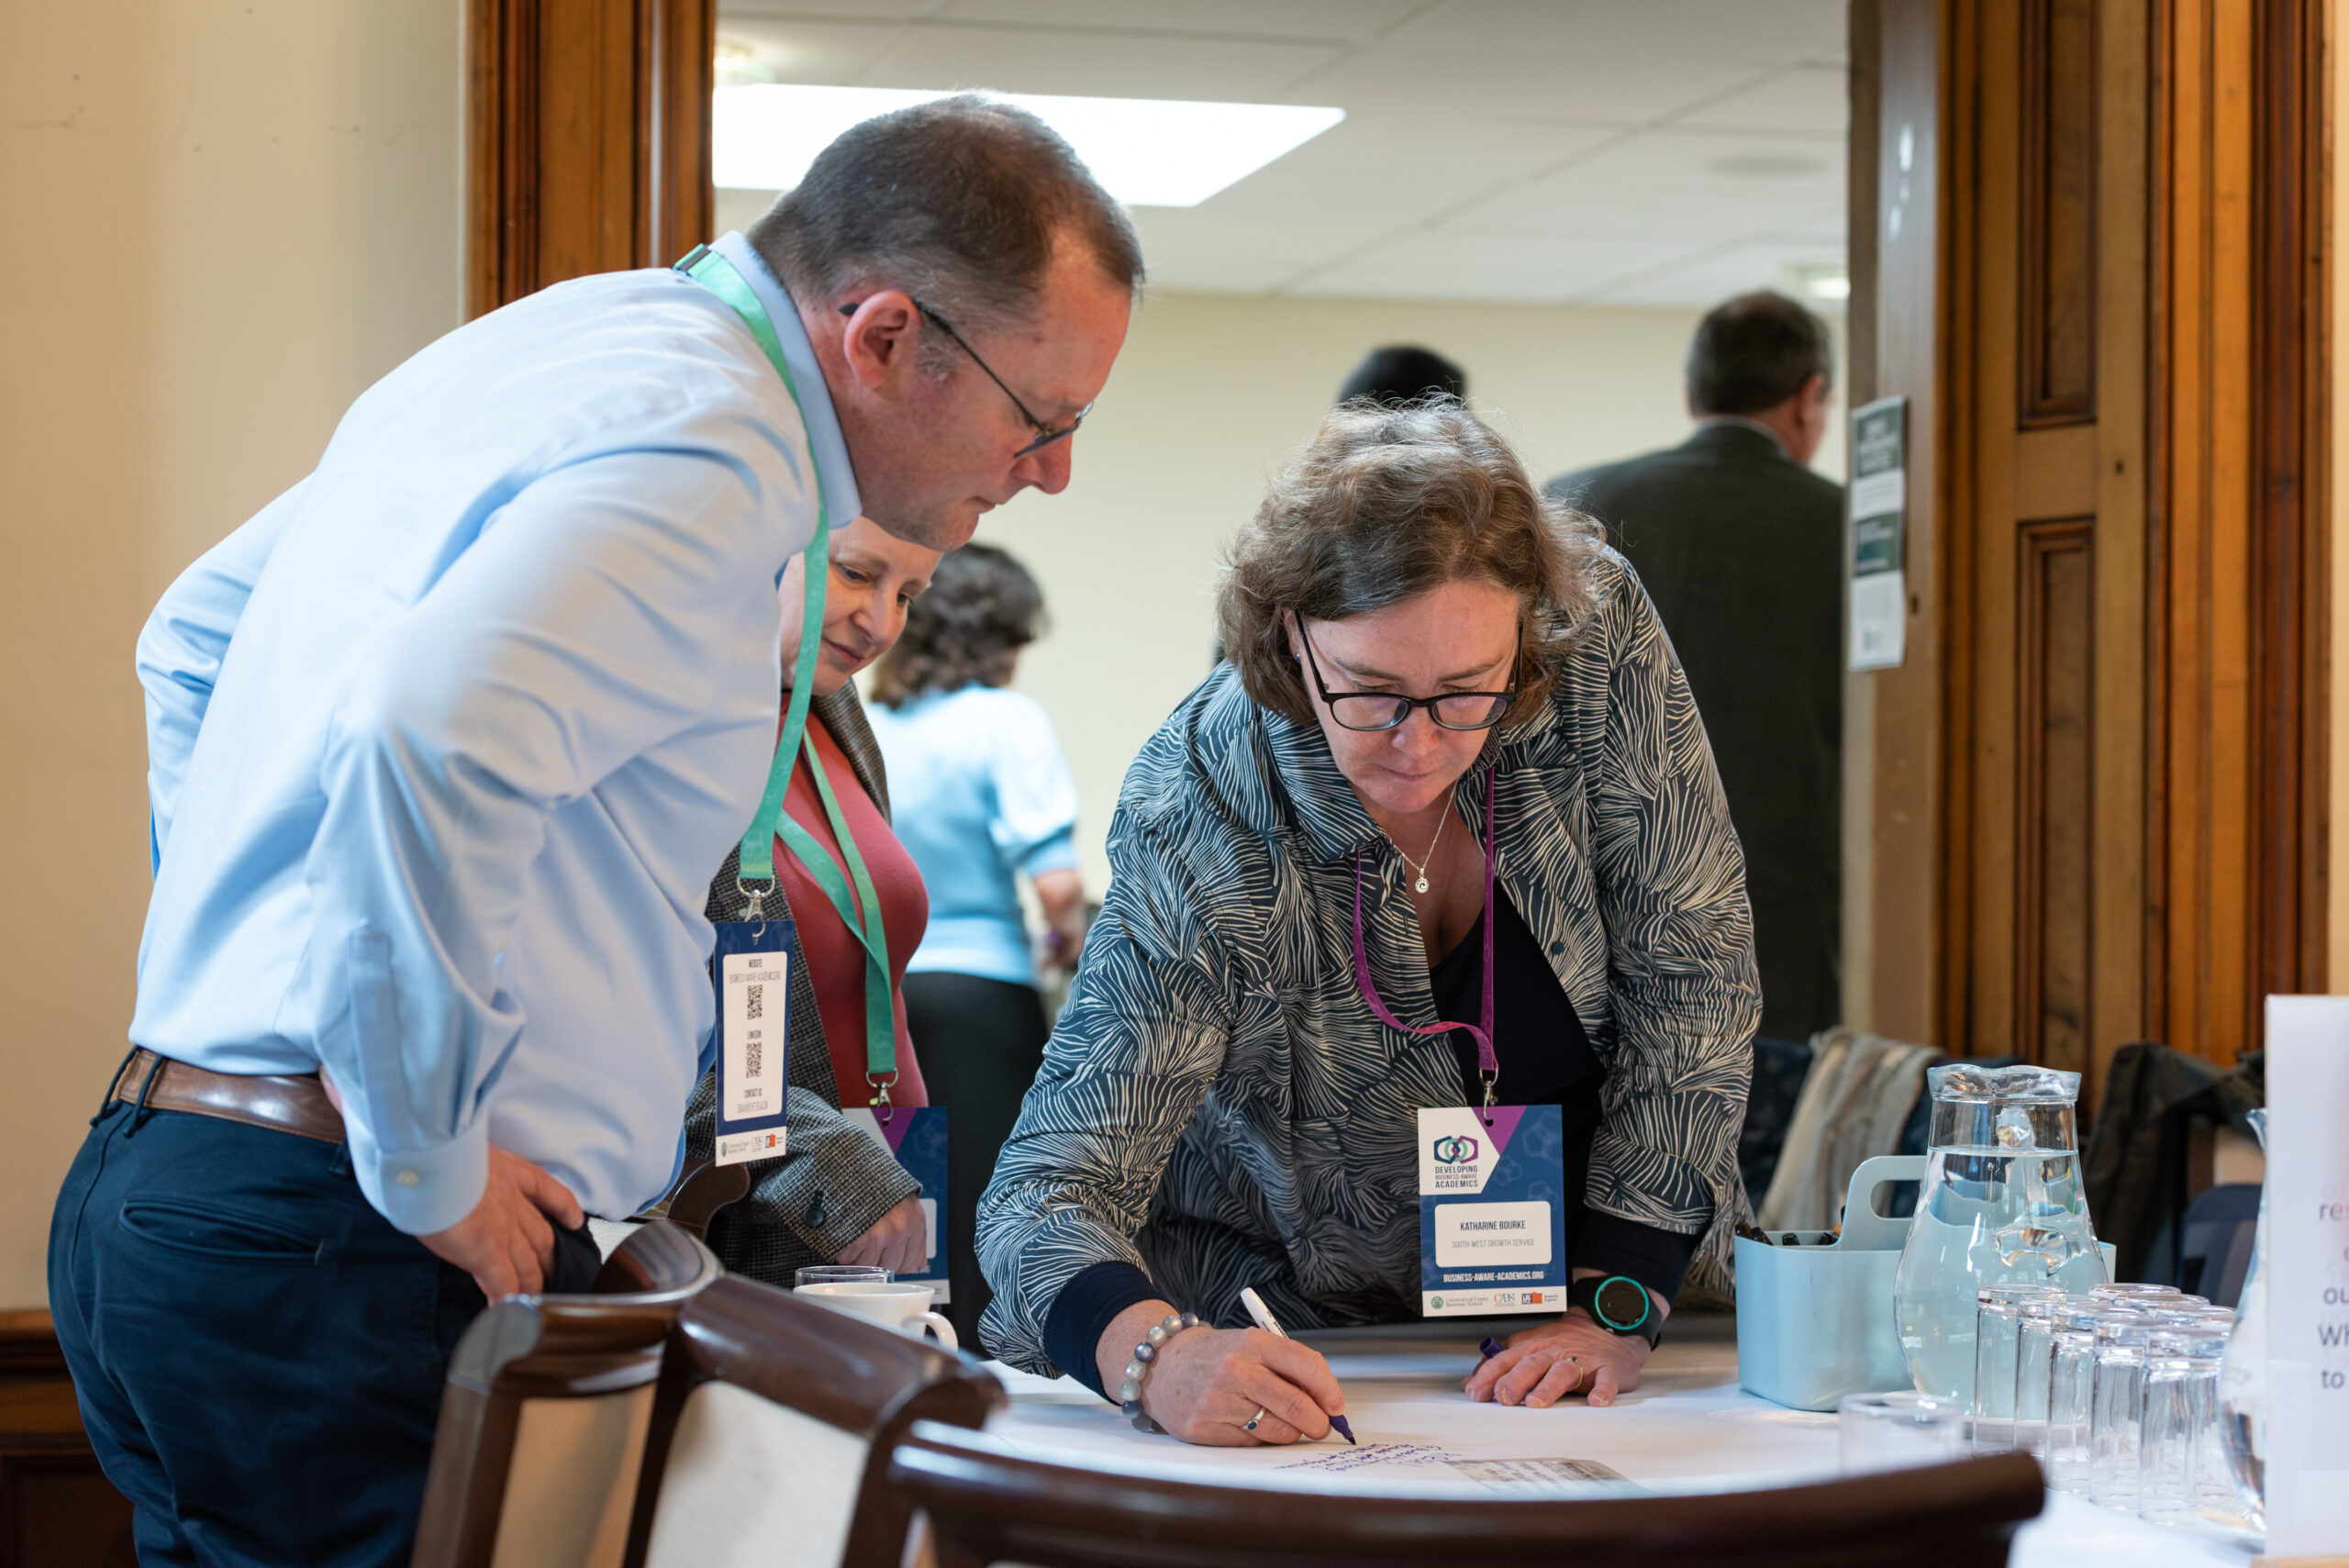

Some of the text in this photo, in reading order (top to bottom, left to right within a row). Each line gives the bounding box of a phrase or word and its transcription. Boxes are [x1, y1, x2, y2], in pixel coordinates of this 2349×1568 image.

[1435, 1165, 1478, 1173] DEVELOPING
[1435, 1180, 1478, 1188] ACADEMICS
[1460, 1220, 1526, 1231] KATHARINE BOURKE
[1452, 1239, 1534, 1249] SOUTH WEST GROWTH SERVICE
[1443, 1271, 1544, 1283] BUSINESS-AWARE-ACADEMICS.ORG
[2321, 1369, 2345, 1390] to
